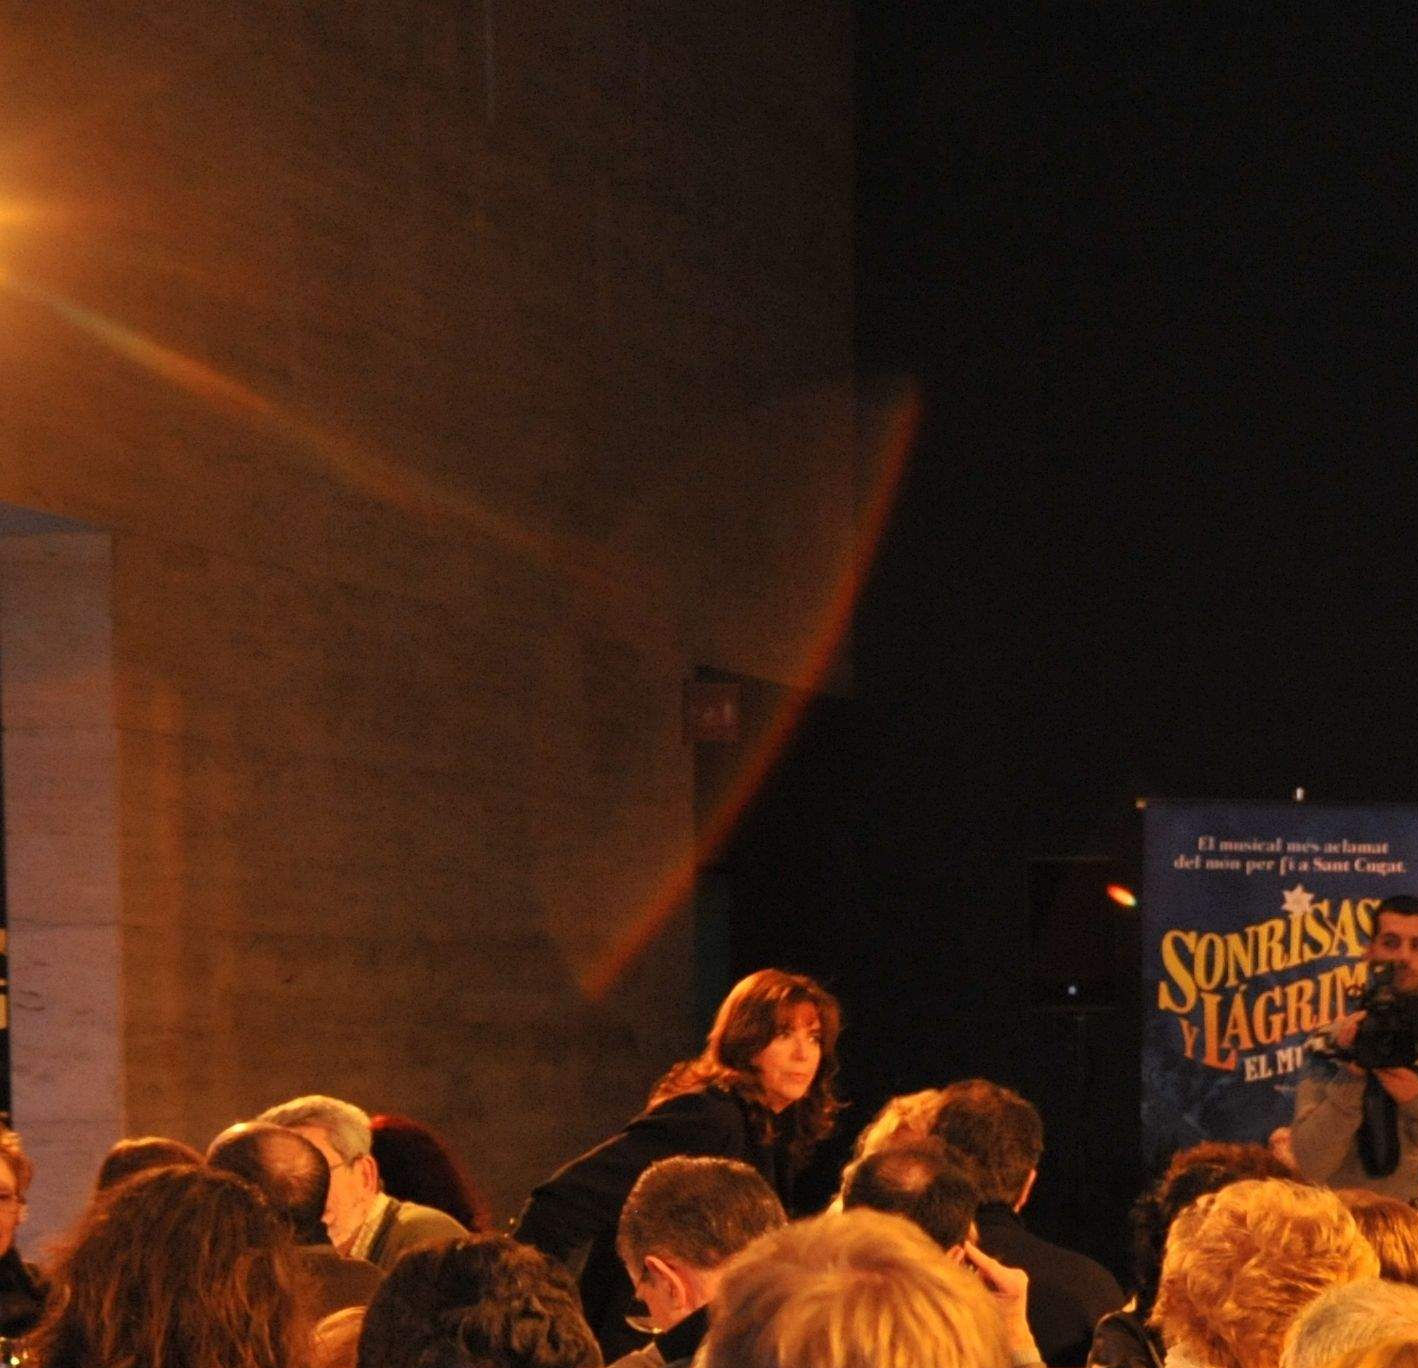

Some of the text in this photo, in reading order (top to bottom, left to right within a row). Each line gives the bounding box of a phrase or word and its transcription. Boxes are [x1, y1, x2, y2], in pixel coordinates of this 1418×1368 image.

[1198, 836, 1215, 851] El
[1219, 837, 1283, 852] musical
[1323, 838, 1389, 854] aclamat
[1174, 854, 1202, 869] del
[1245, 859, 1275, 876] per
[1280, 856, 1295, 876] fi
[1298, 861, 1309, 872] a
[1313, 857, 1350, 872] Sant
[1200, 961, 1369, 1071] LÁGRIM
[1243, 1054, 1272, 1081] EL
